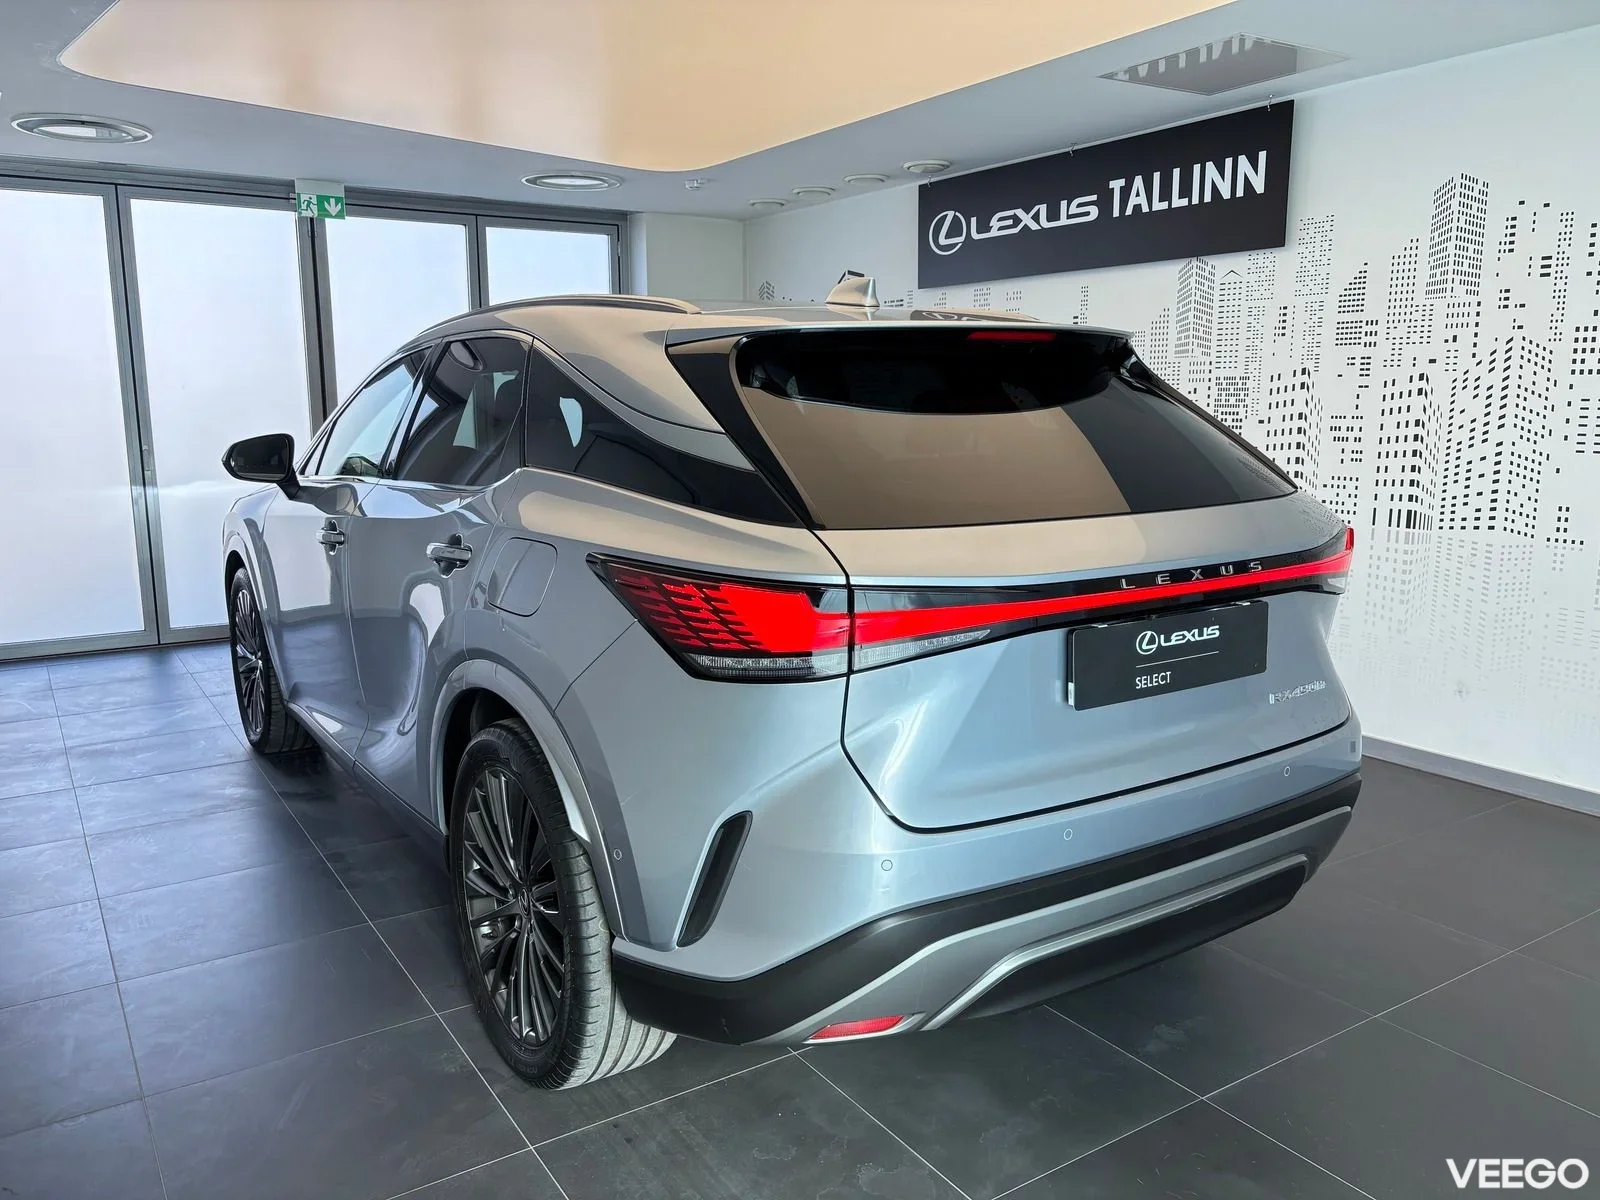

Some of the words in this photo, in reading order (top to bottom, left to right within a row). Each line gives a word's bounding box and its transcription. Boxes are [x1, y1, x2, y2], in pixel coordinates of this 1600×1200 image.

[970, 194, 1099, 240] LEXUS
[1109, 150, 1267, 218] TALLINN
[1120, 561, 1262, 589] LEXUS
[1160, 625, 1220, 647] LEXUS
[1135, 671, 1172, 689] SELECT
